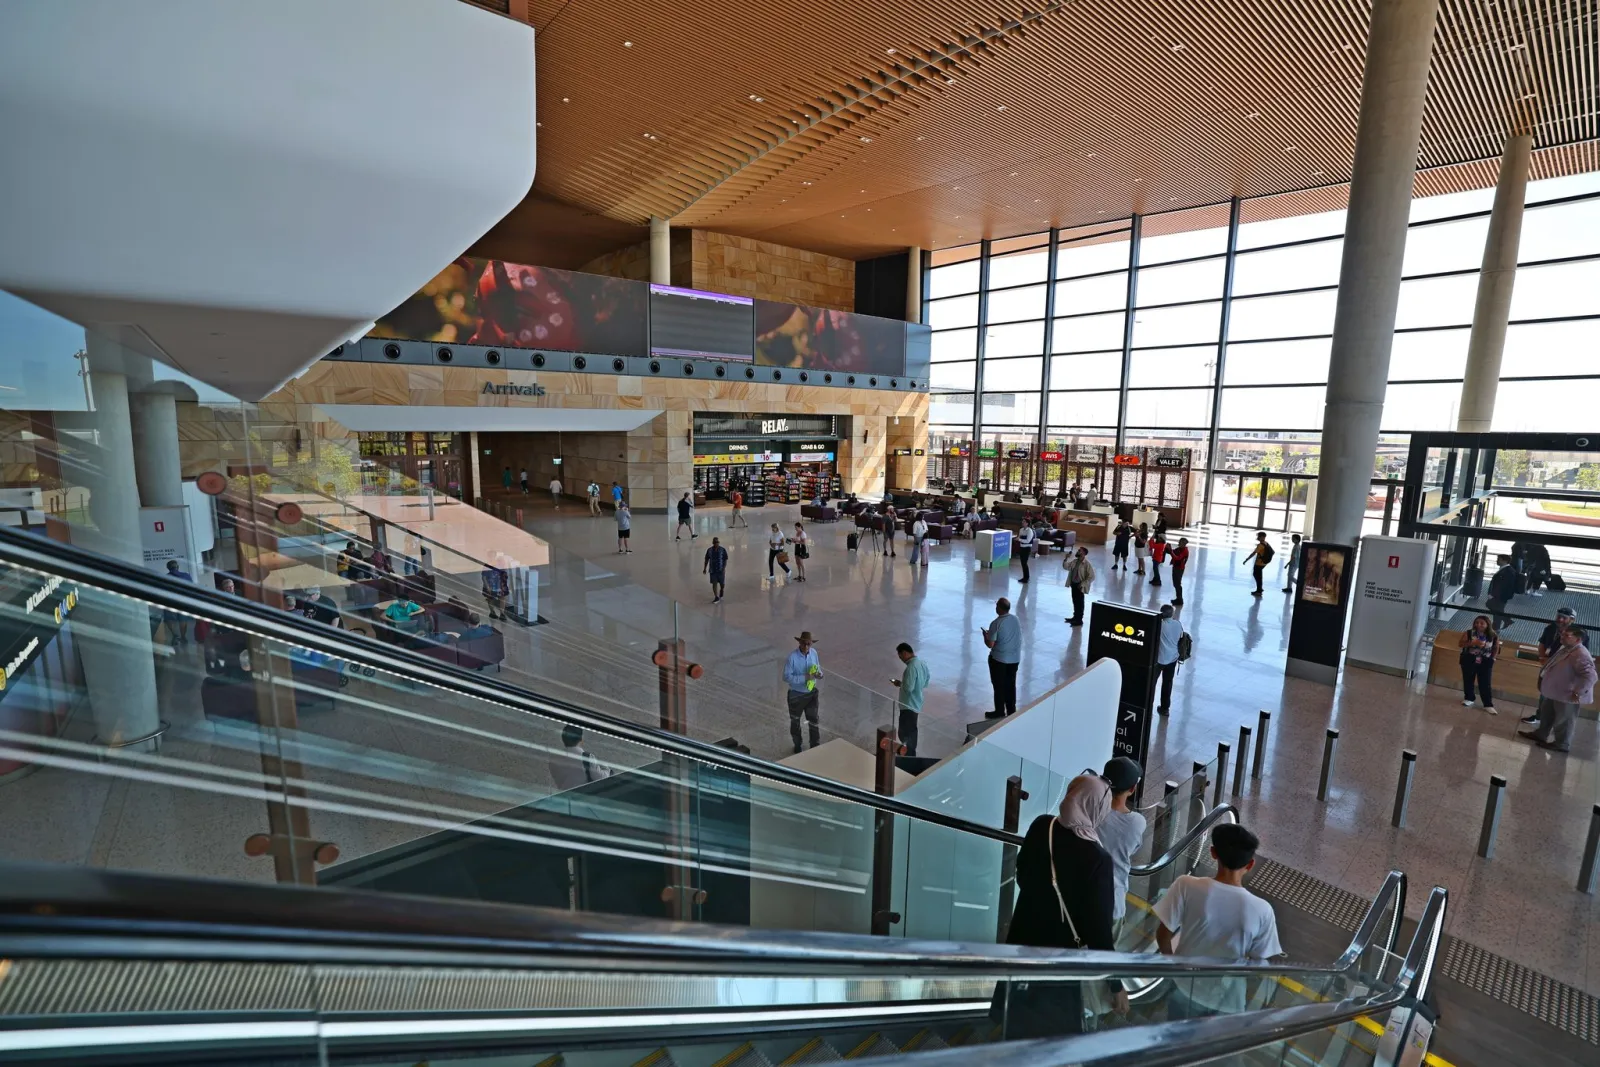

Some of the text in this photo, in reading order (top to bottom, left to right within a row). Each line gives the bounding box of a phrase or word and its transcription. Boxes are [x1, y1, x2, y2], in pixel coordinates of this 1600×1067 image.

[482, 381, 546, 396] Arrivals
[762, 419, 786, 434] RELAY
[1110, 633, 1144, 646] Departures
